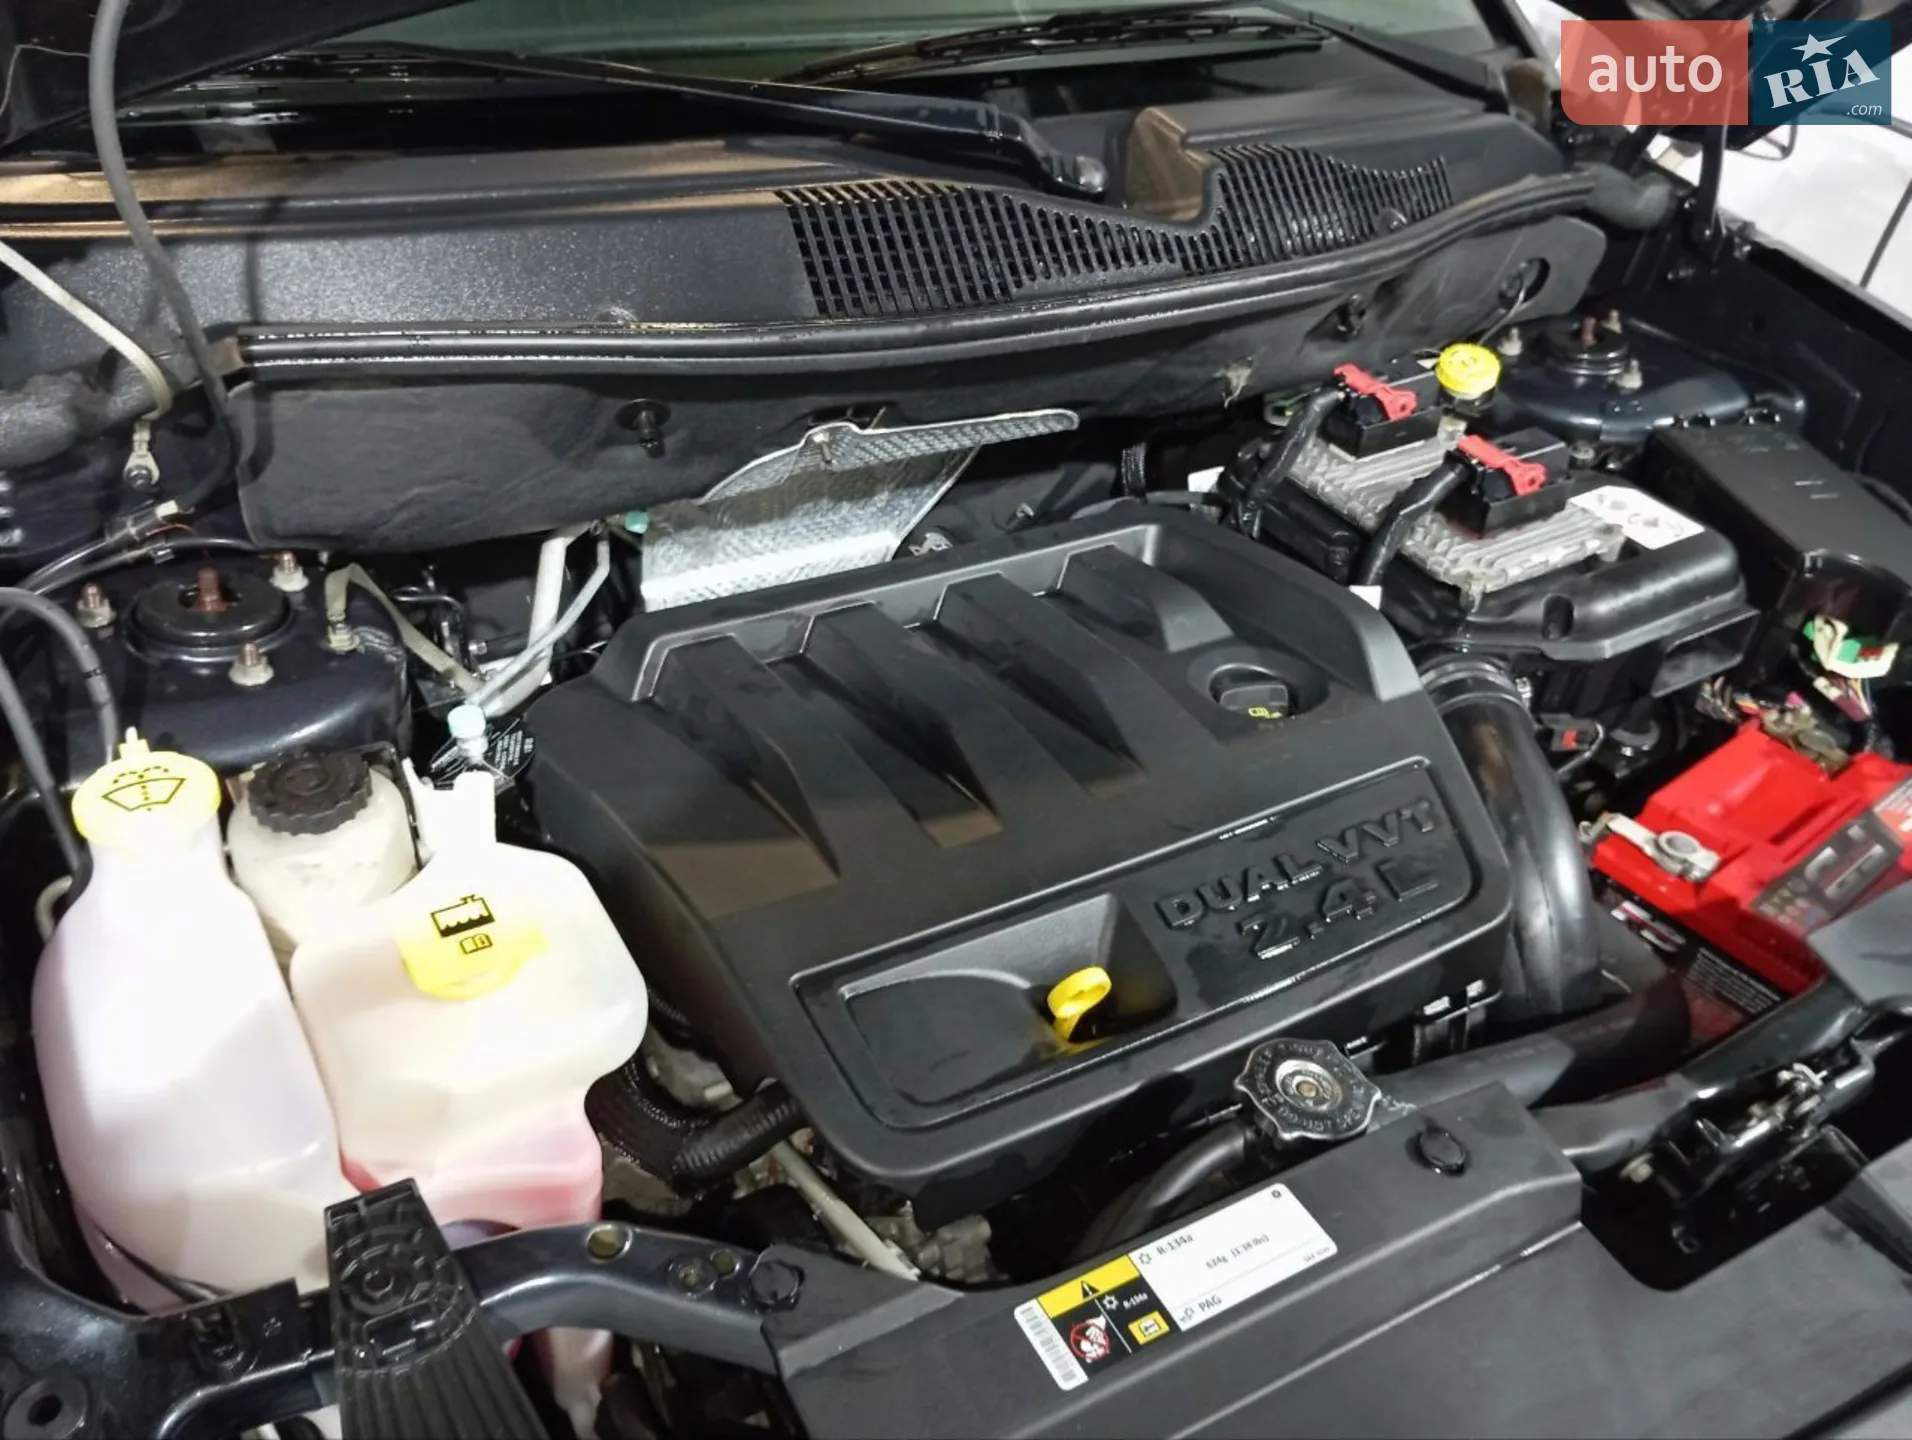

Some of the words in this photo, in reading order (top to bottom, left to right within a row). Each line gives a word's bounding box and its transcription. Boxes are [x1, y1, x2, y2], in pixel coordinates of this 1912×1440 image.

[1157, 855, 1322, 927] DUAL
[1315, 798, 1436, 863] VVT
[1238, 857, 1440, 960] 2.4L
[1156, 1234, 1194, 1255] R-134a
[1198, 1295, 1222, 1312] PAG
